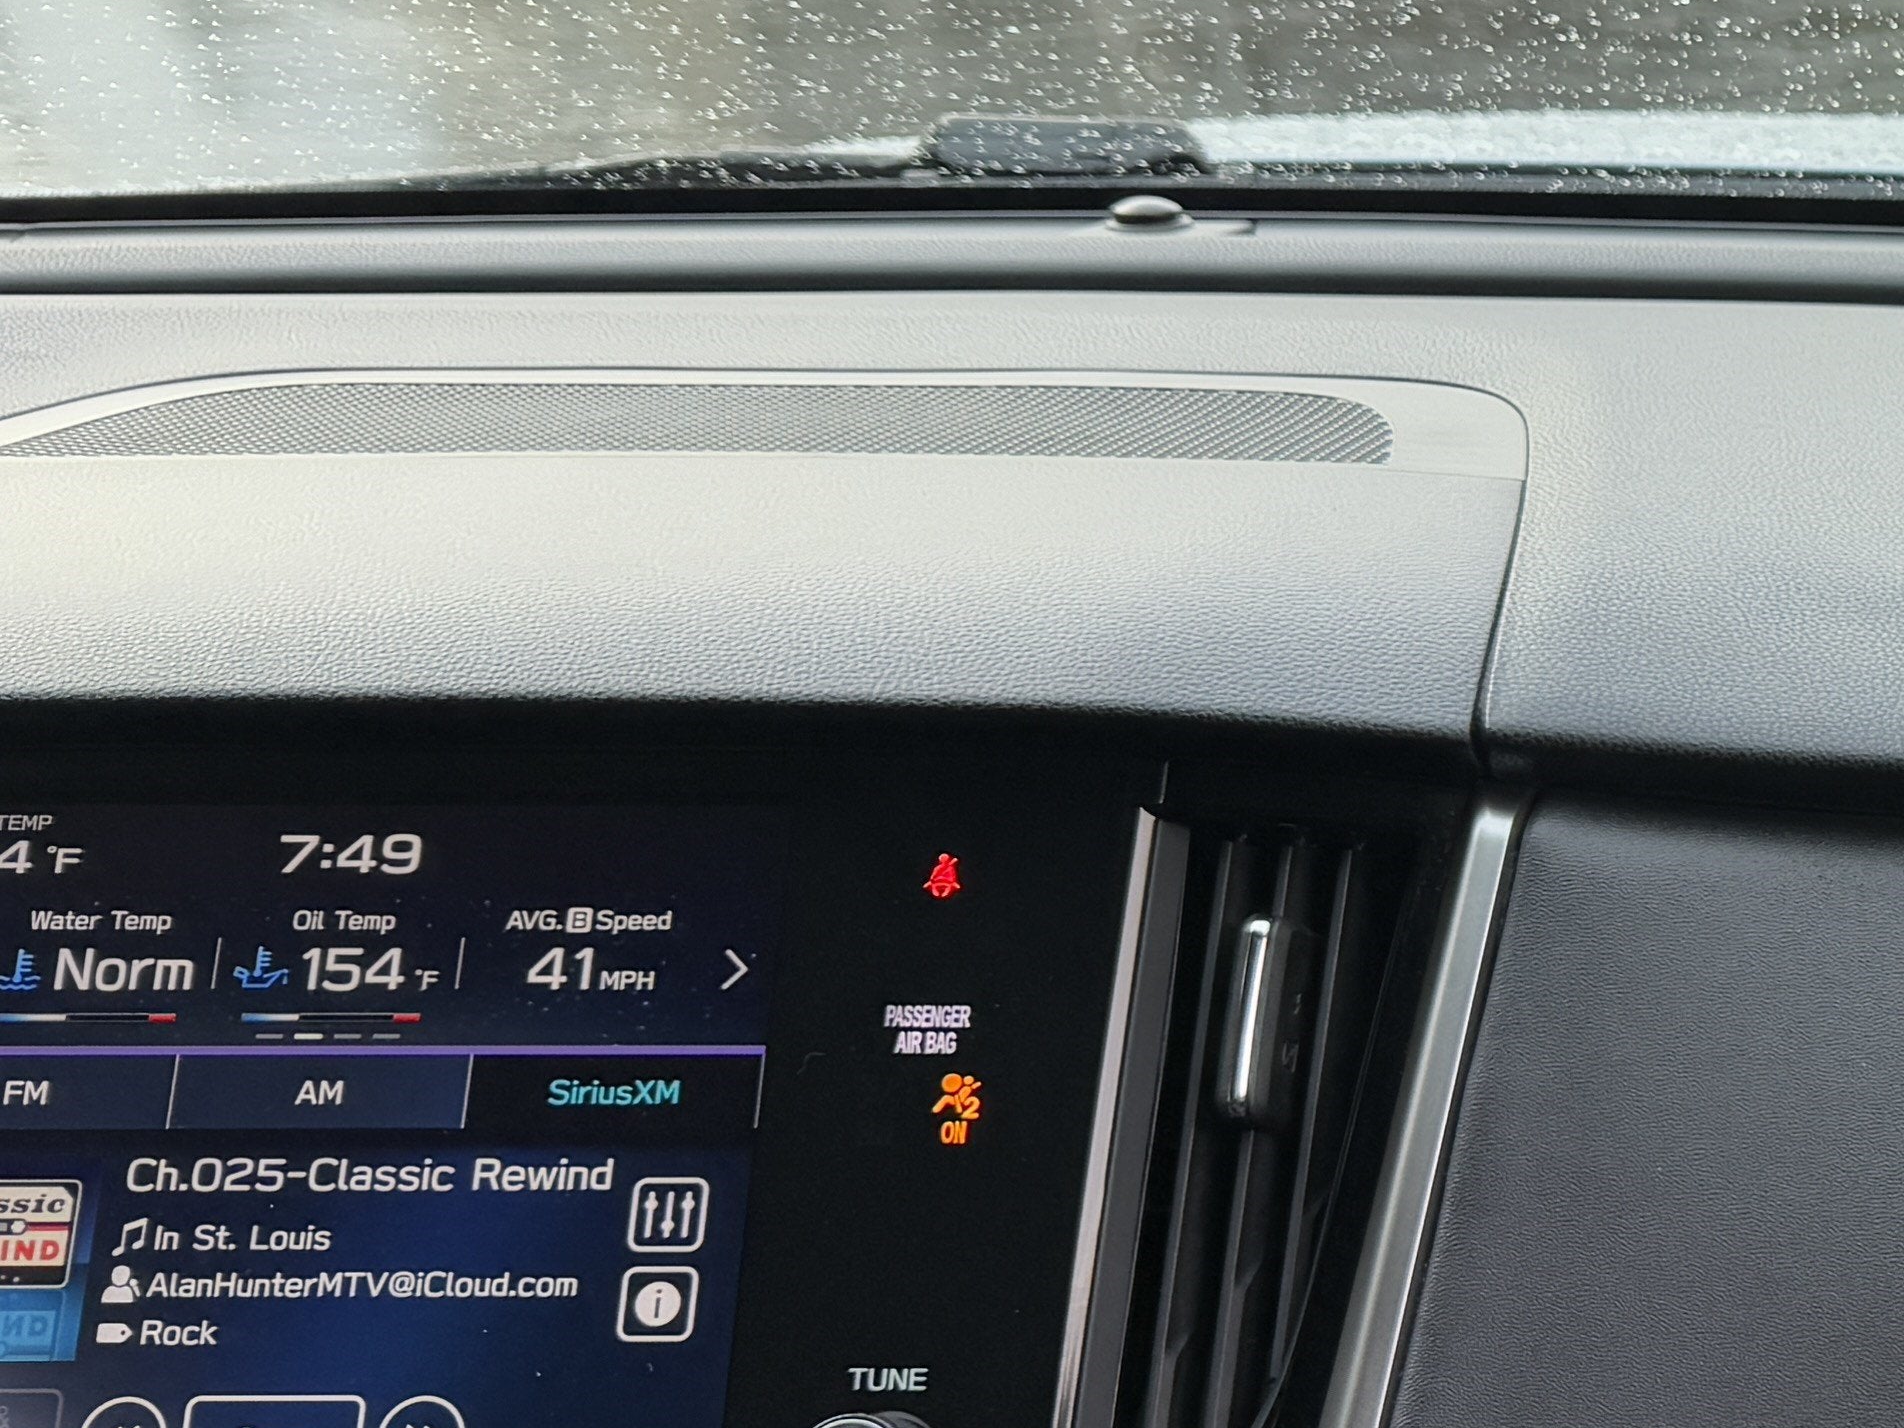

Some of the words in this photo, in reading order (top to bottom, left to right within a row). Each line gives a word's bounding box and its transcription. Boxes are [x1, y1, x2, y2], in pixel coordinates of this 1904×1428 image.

[281, 833, 422, 874] 7:49
[31, 910, 103, 930] Water
[110, 910, 172, 935] Temp
[292, 910, 325, 930] Oil
[334, 910, 396, 935] Temp
[505, 910, 563, 930] AVG.
[596, 909, 673, 935] Speed
[53, 947, 194, 992] Norm
[302, 947, 405, 991] 154
[526, 947, 594, 991] 41
[599, 971, 656, 991] MPH
[884, 1004, 972, 1028] PASSENGER
[893, 1031, 922, 1054] AIR
[923, 1031, 957, 1054] BAG
[3, 1080, 49, 1105] FM
[295, 1080, 344, 1105] AM
[547, 1079, 681, 1105] SiriusXM
[941, 1120, 968, 1144] ON
[471, 1157, 615, 1192] Rewind
[153, 1225, 180, 1251] In
[192, 1225, 236, 1251] St.
[249, 1224, 332, 1251] Louis
[145, 1270, 578, 1299] AlanHunterMTV@iCloud.com
[139, 1319, 218, 1346] Rock
[848, 1367, 929, 1392] TUNE
